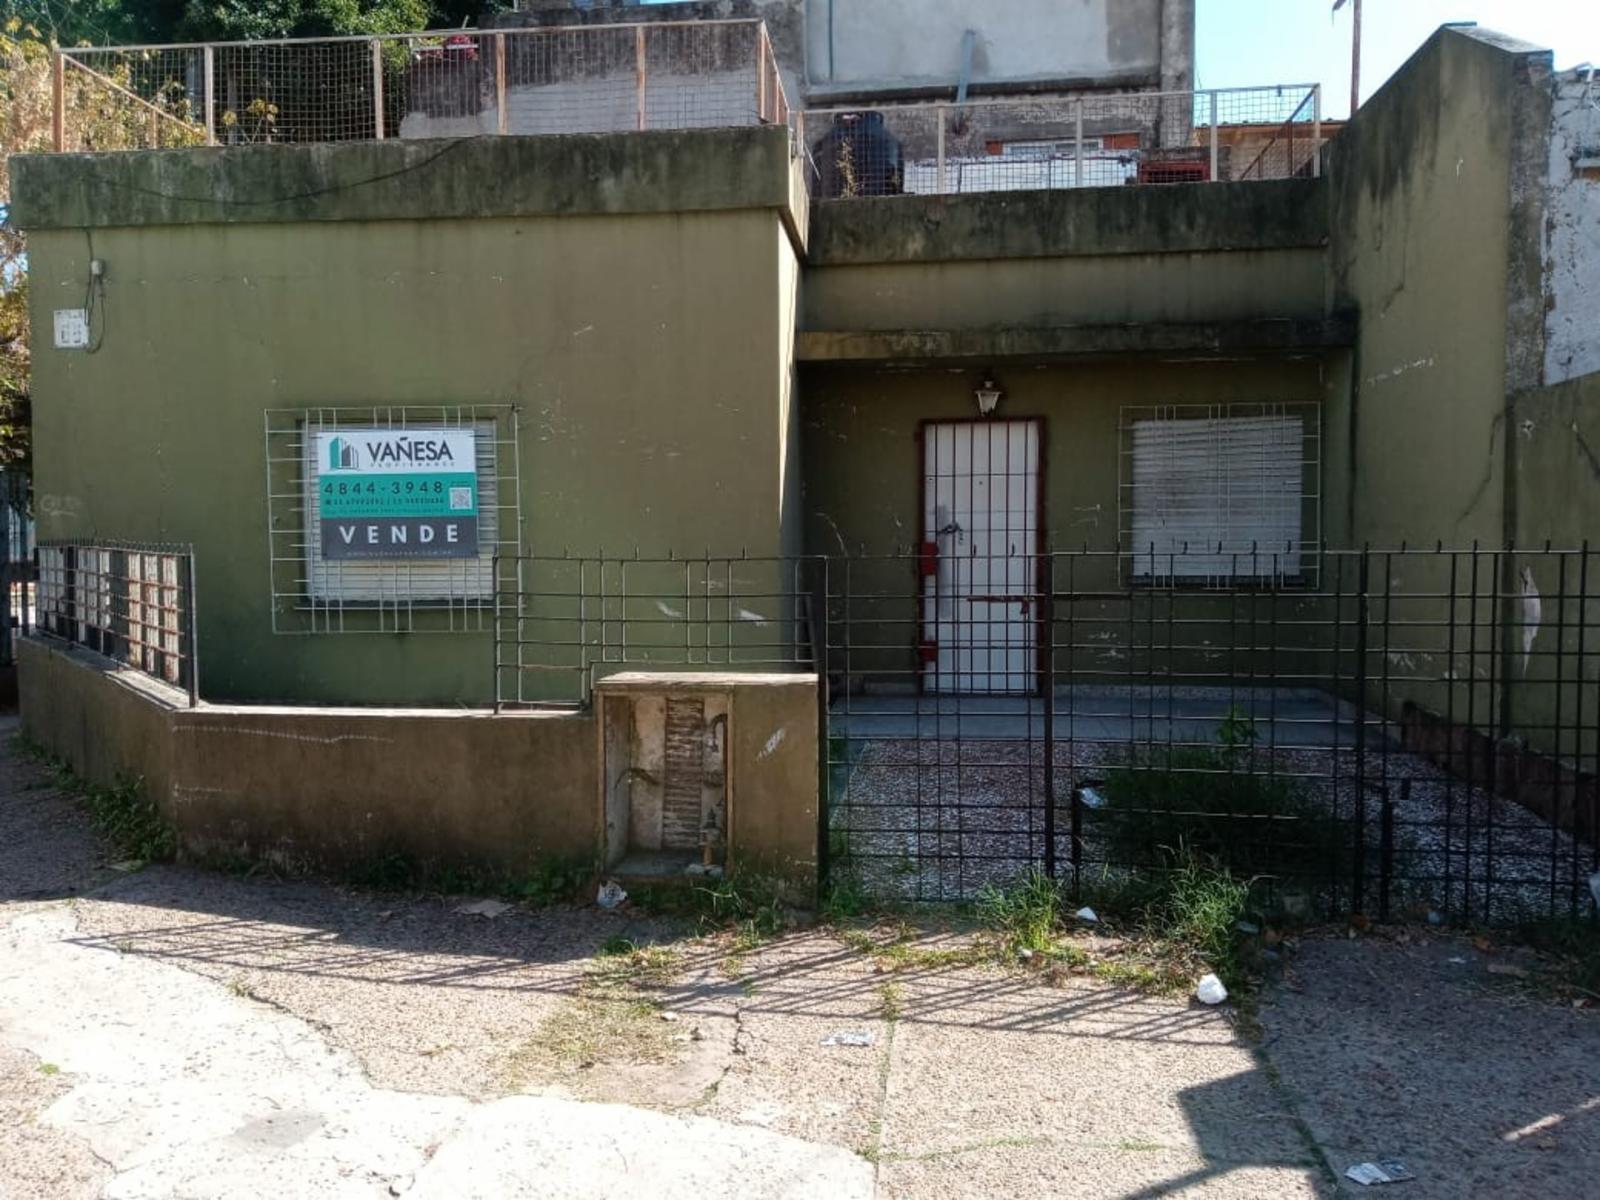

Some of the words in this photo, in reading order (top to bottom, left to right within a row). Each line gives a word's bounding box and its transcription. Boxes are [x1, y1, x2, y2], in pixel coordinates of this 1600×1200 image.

[366, 437, 454, 462] VAÑESA
[324, 481, 443, 495] 4844-3948
[339, 524, 458, 544] VENDE
